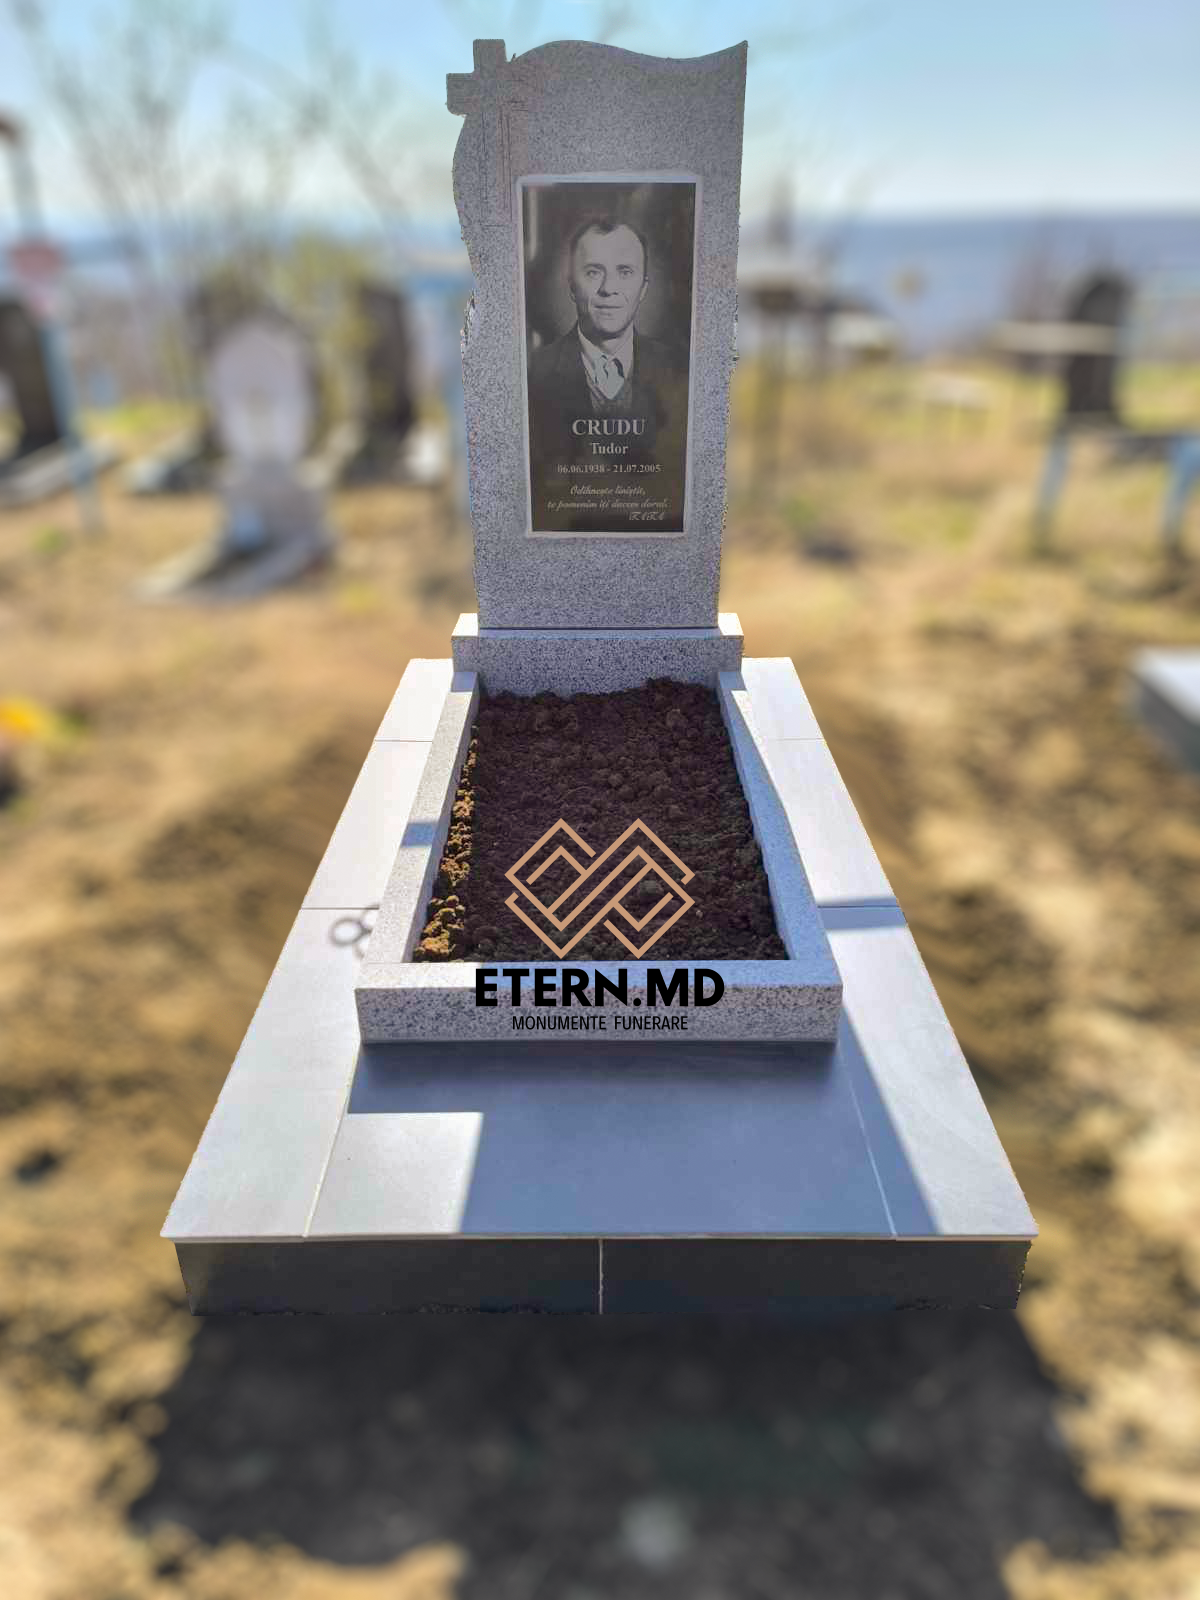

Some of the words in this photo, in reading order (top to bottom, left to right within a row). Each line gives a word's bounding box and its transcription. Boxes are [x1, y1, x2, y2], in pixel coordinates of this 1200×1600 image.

[572, 419, 645, 436] CRUDU
[590, 443, 629, 455] Tudor
[557, 464, 606, 473] 06.06.1938
[613, 464, 662, 473] 21.07.2005
